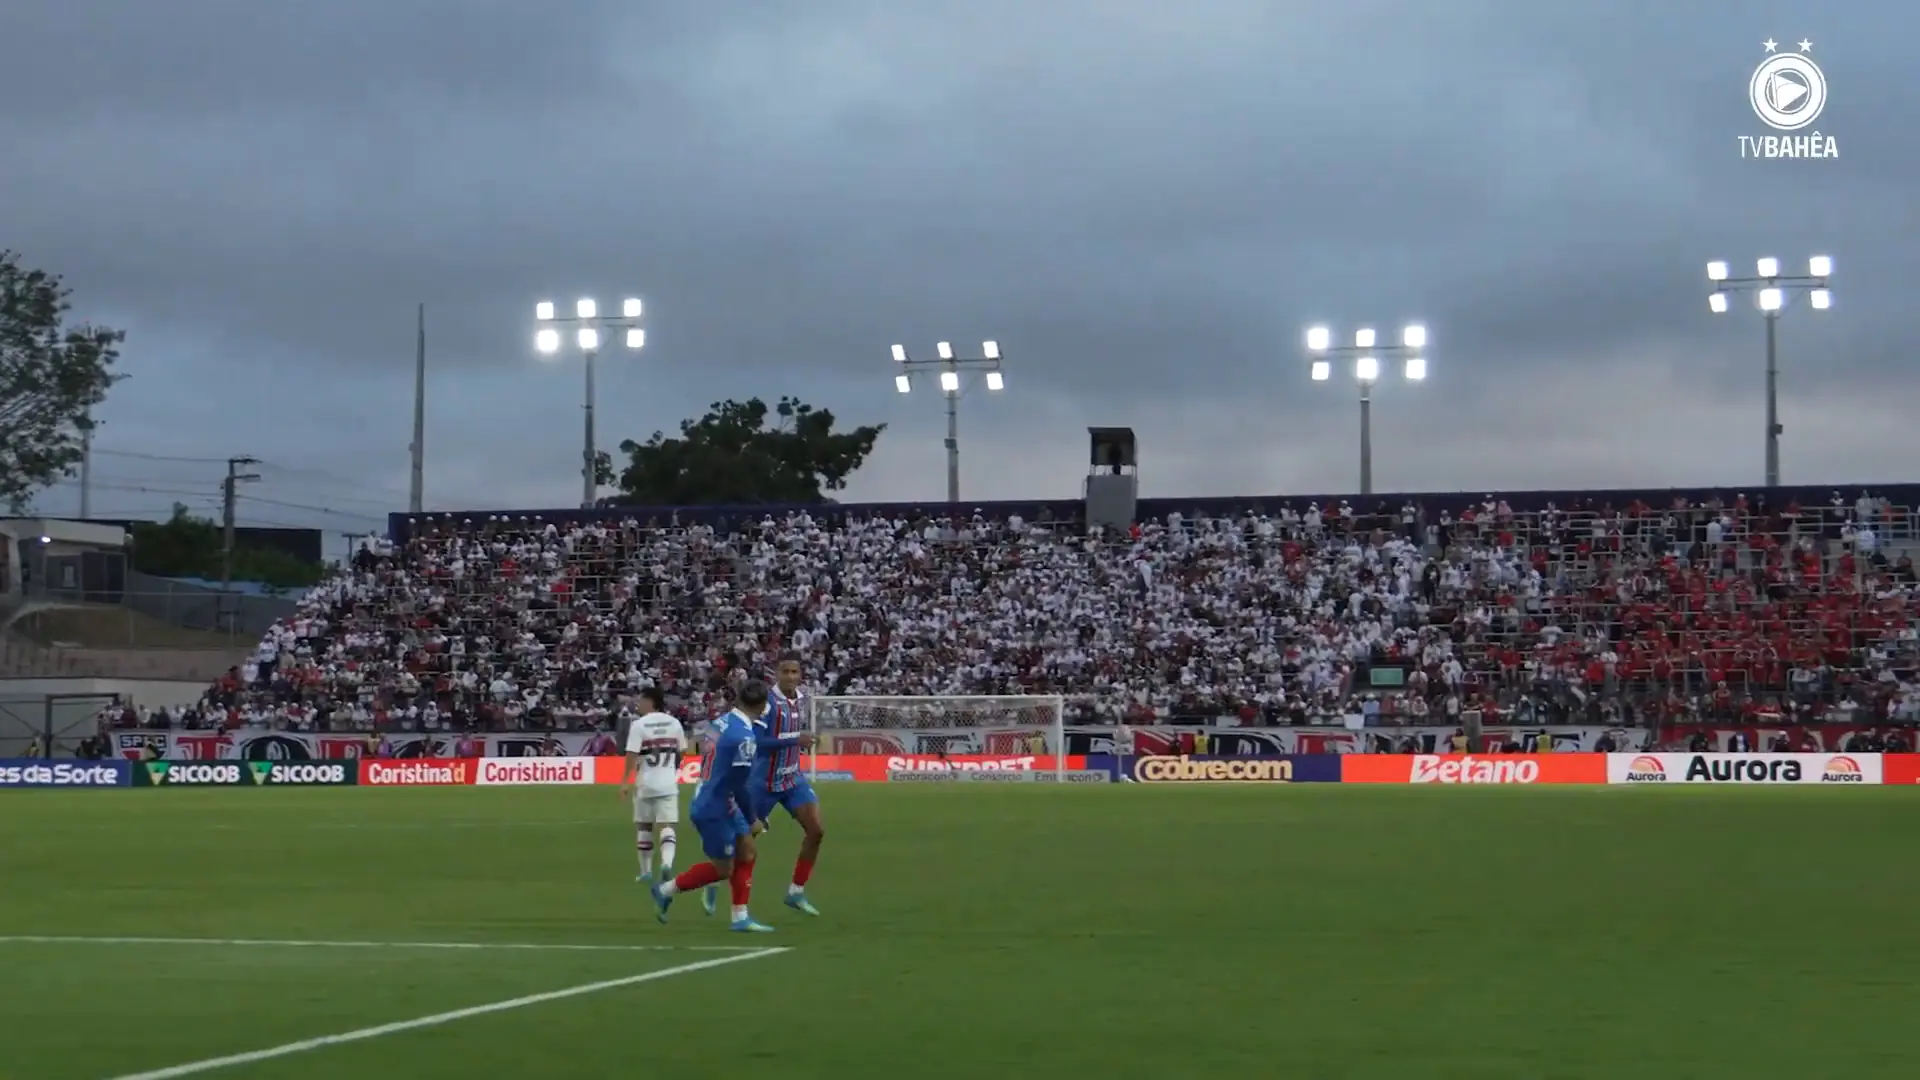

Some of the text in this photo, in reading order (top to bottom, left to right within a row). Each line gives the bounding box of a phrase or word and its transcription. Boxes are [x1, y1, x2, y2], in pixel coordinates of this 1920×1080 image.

[23, 764, 52, 784] da
[53, 763, 118, 784] Sorte
[169, 765, 241, 783] SICOOB
[271, 765, 344, 783] SICOOB
[1409, 754, 1539, 783] Betano
[1627, 772, 1666, 782] Aurora
[1686, 756, 1801, 782] Aurora
[1822, 772, 1862, 782] Aurora
